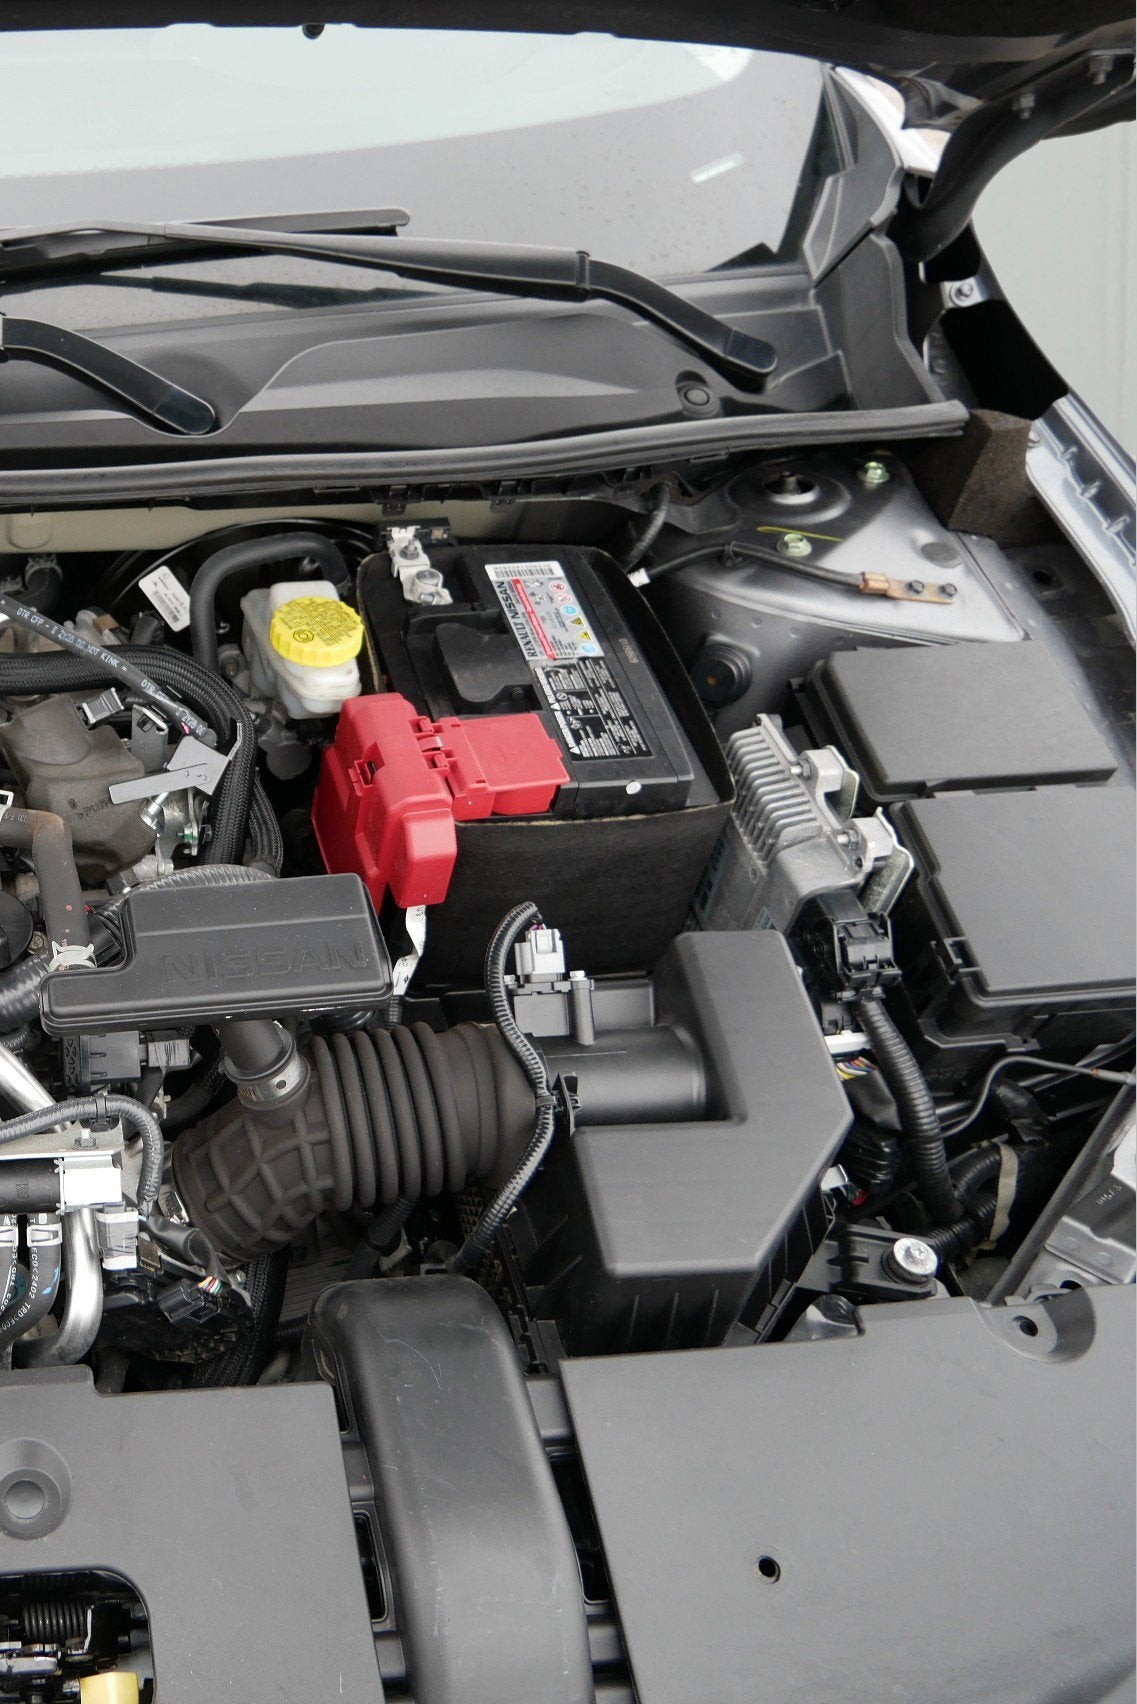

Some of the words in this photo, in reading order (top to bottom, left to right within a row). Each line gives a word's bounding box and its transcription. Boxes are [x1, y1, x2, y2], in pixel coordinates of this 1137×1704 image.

[495, 581, 520, 620] NISSAN
[513, 621, 538, 657] RENAULT
[100, 652, 120, 668] KINK
[161, 940, 369, 984] NISSAN
